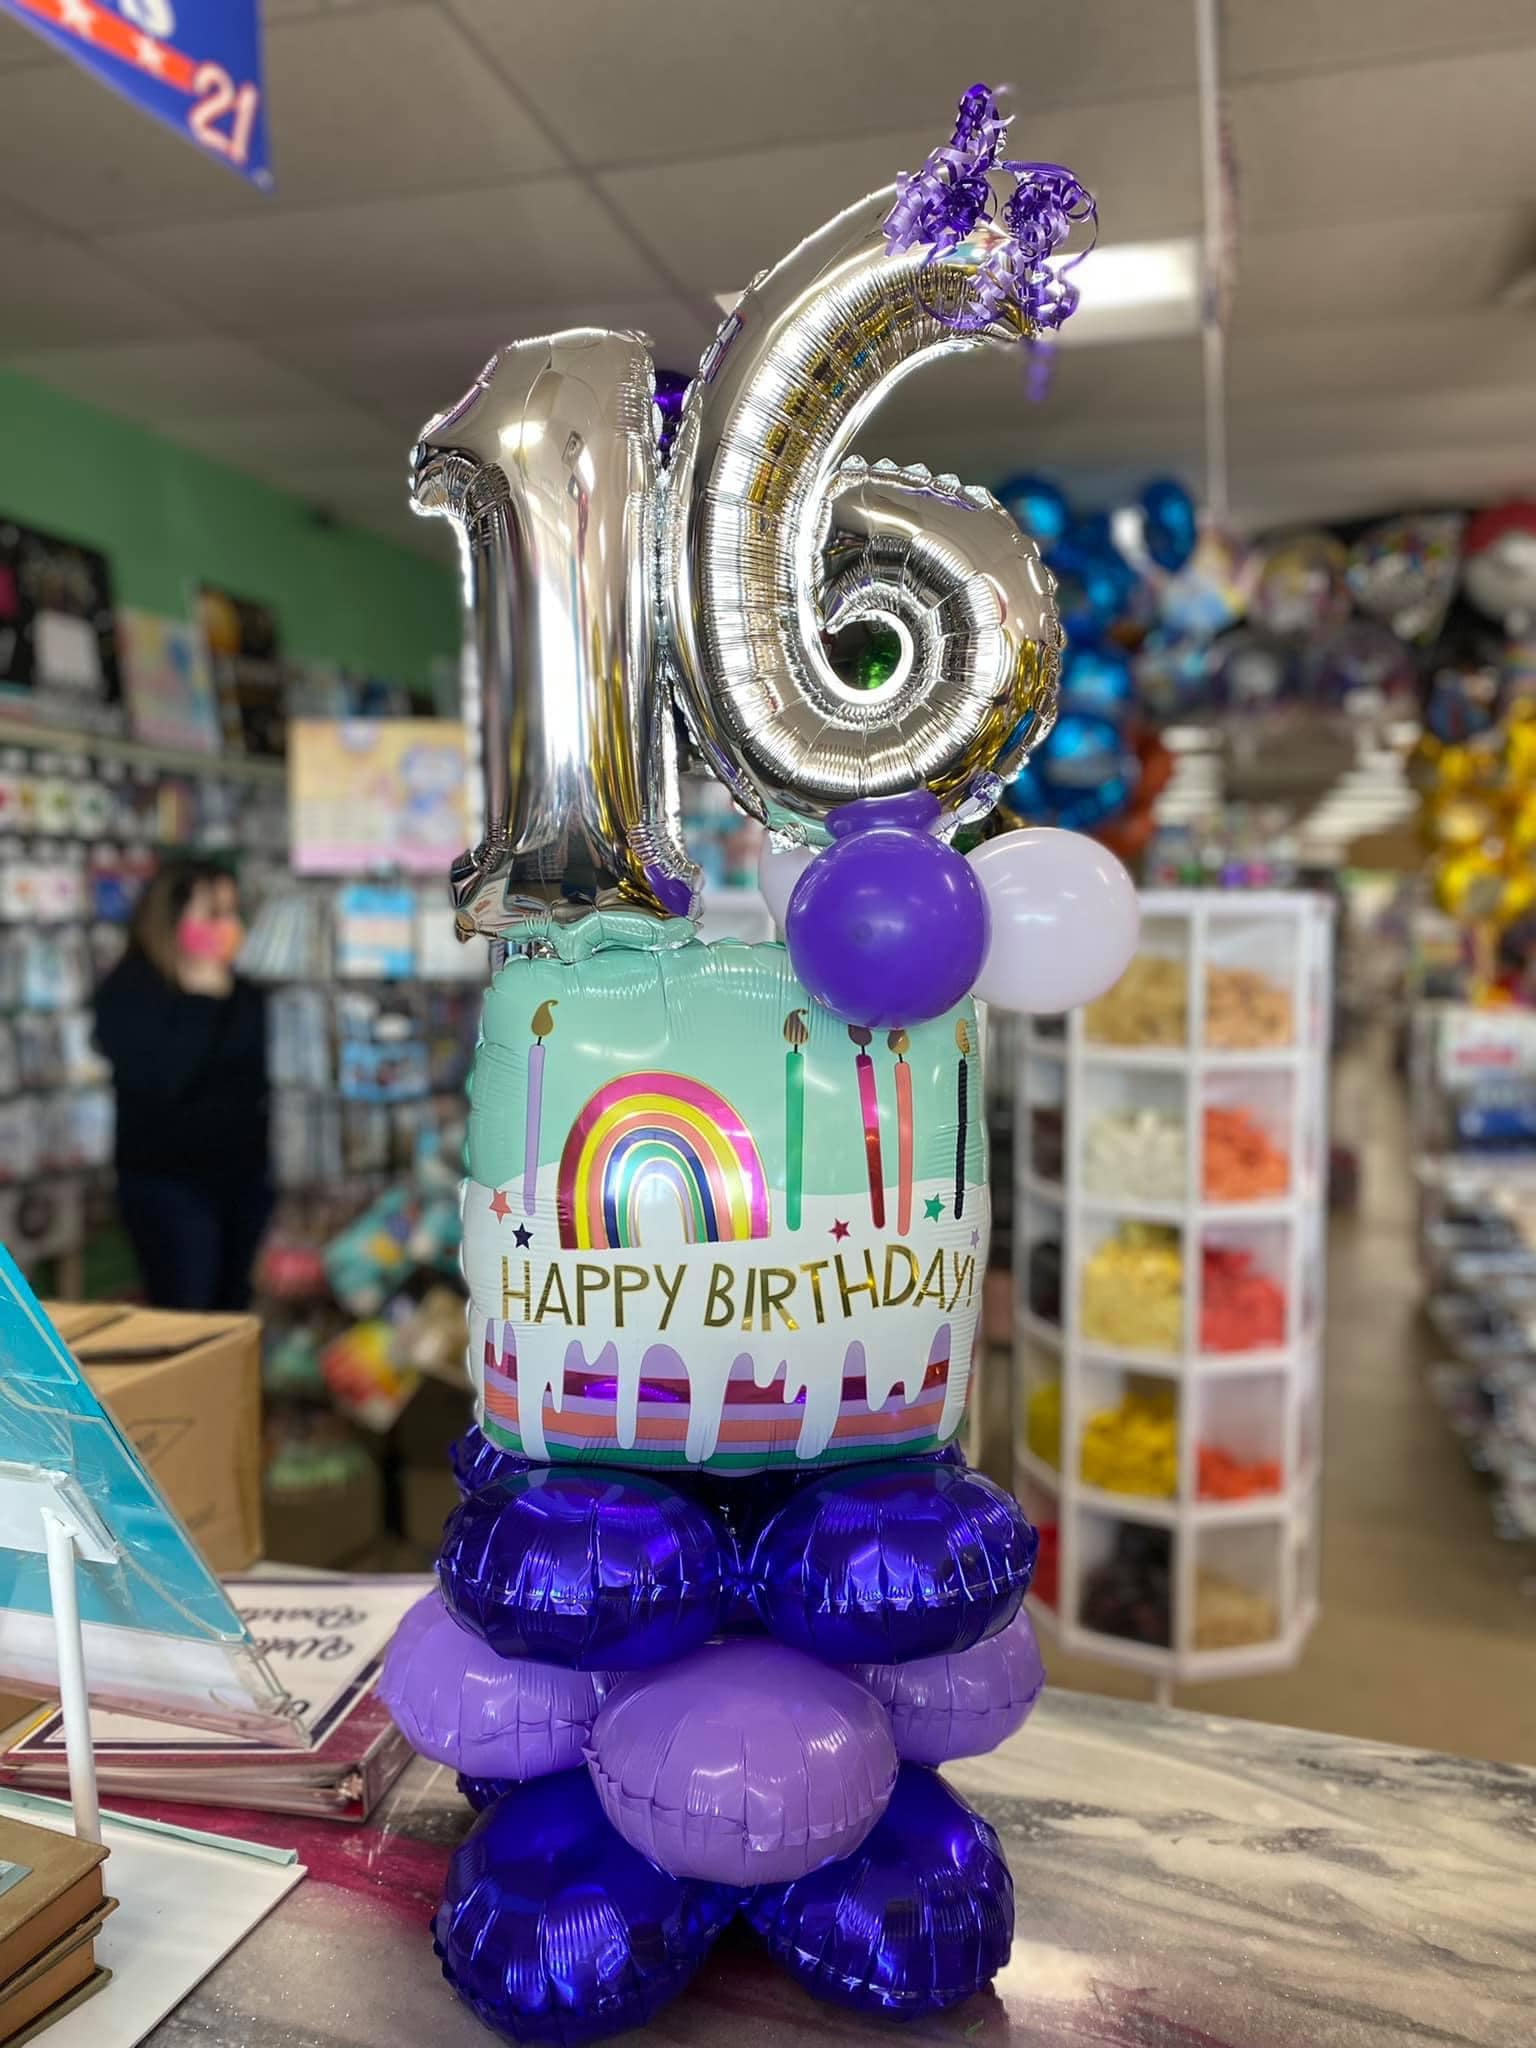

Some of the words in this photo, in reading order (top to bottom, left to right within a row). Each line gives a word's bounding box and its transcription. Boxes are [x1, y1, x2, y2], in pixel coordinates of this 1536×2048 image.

[189, 60, 258, 165] 21
[409, 174, 1066, 938] 16
[501, 1255, 688, 1331] HAPPY
[703, 1244, 975, 1332] BIRTHDAY!
